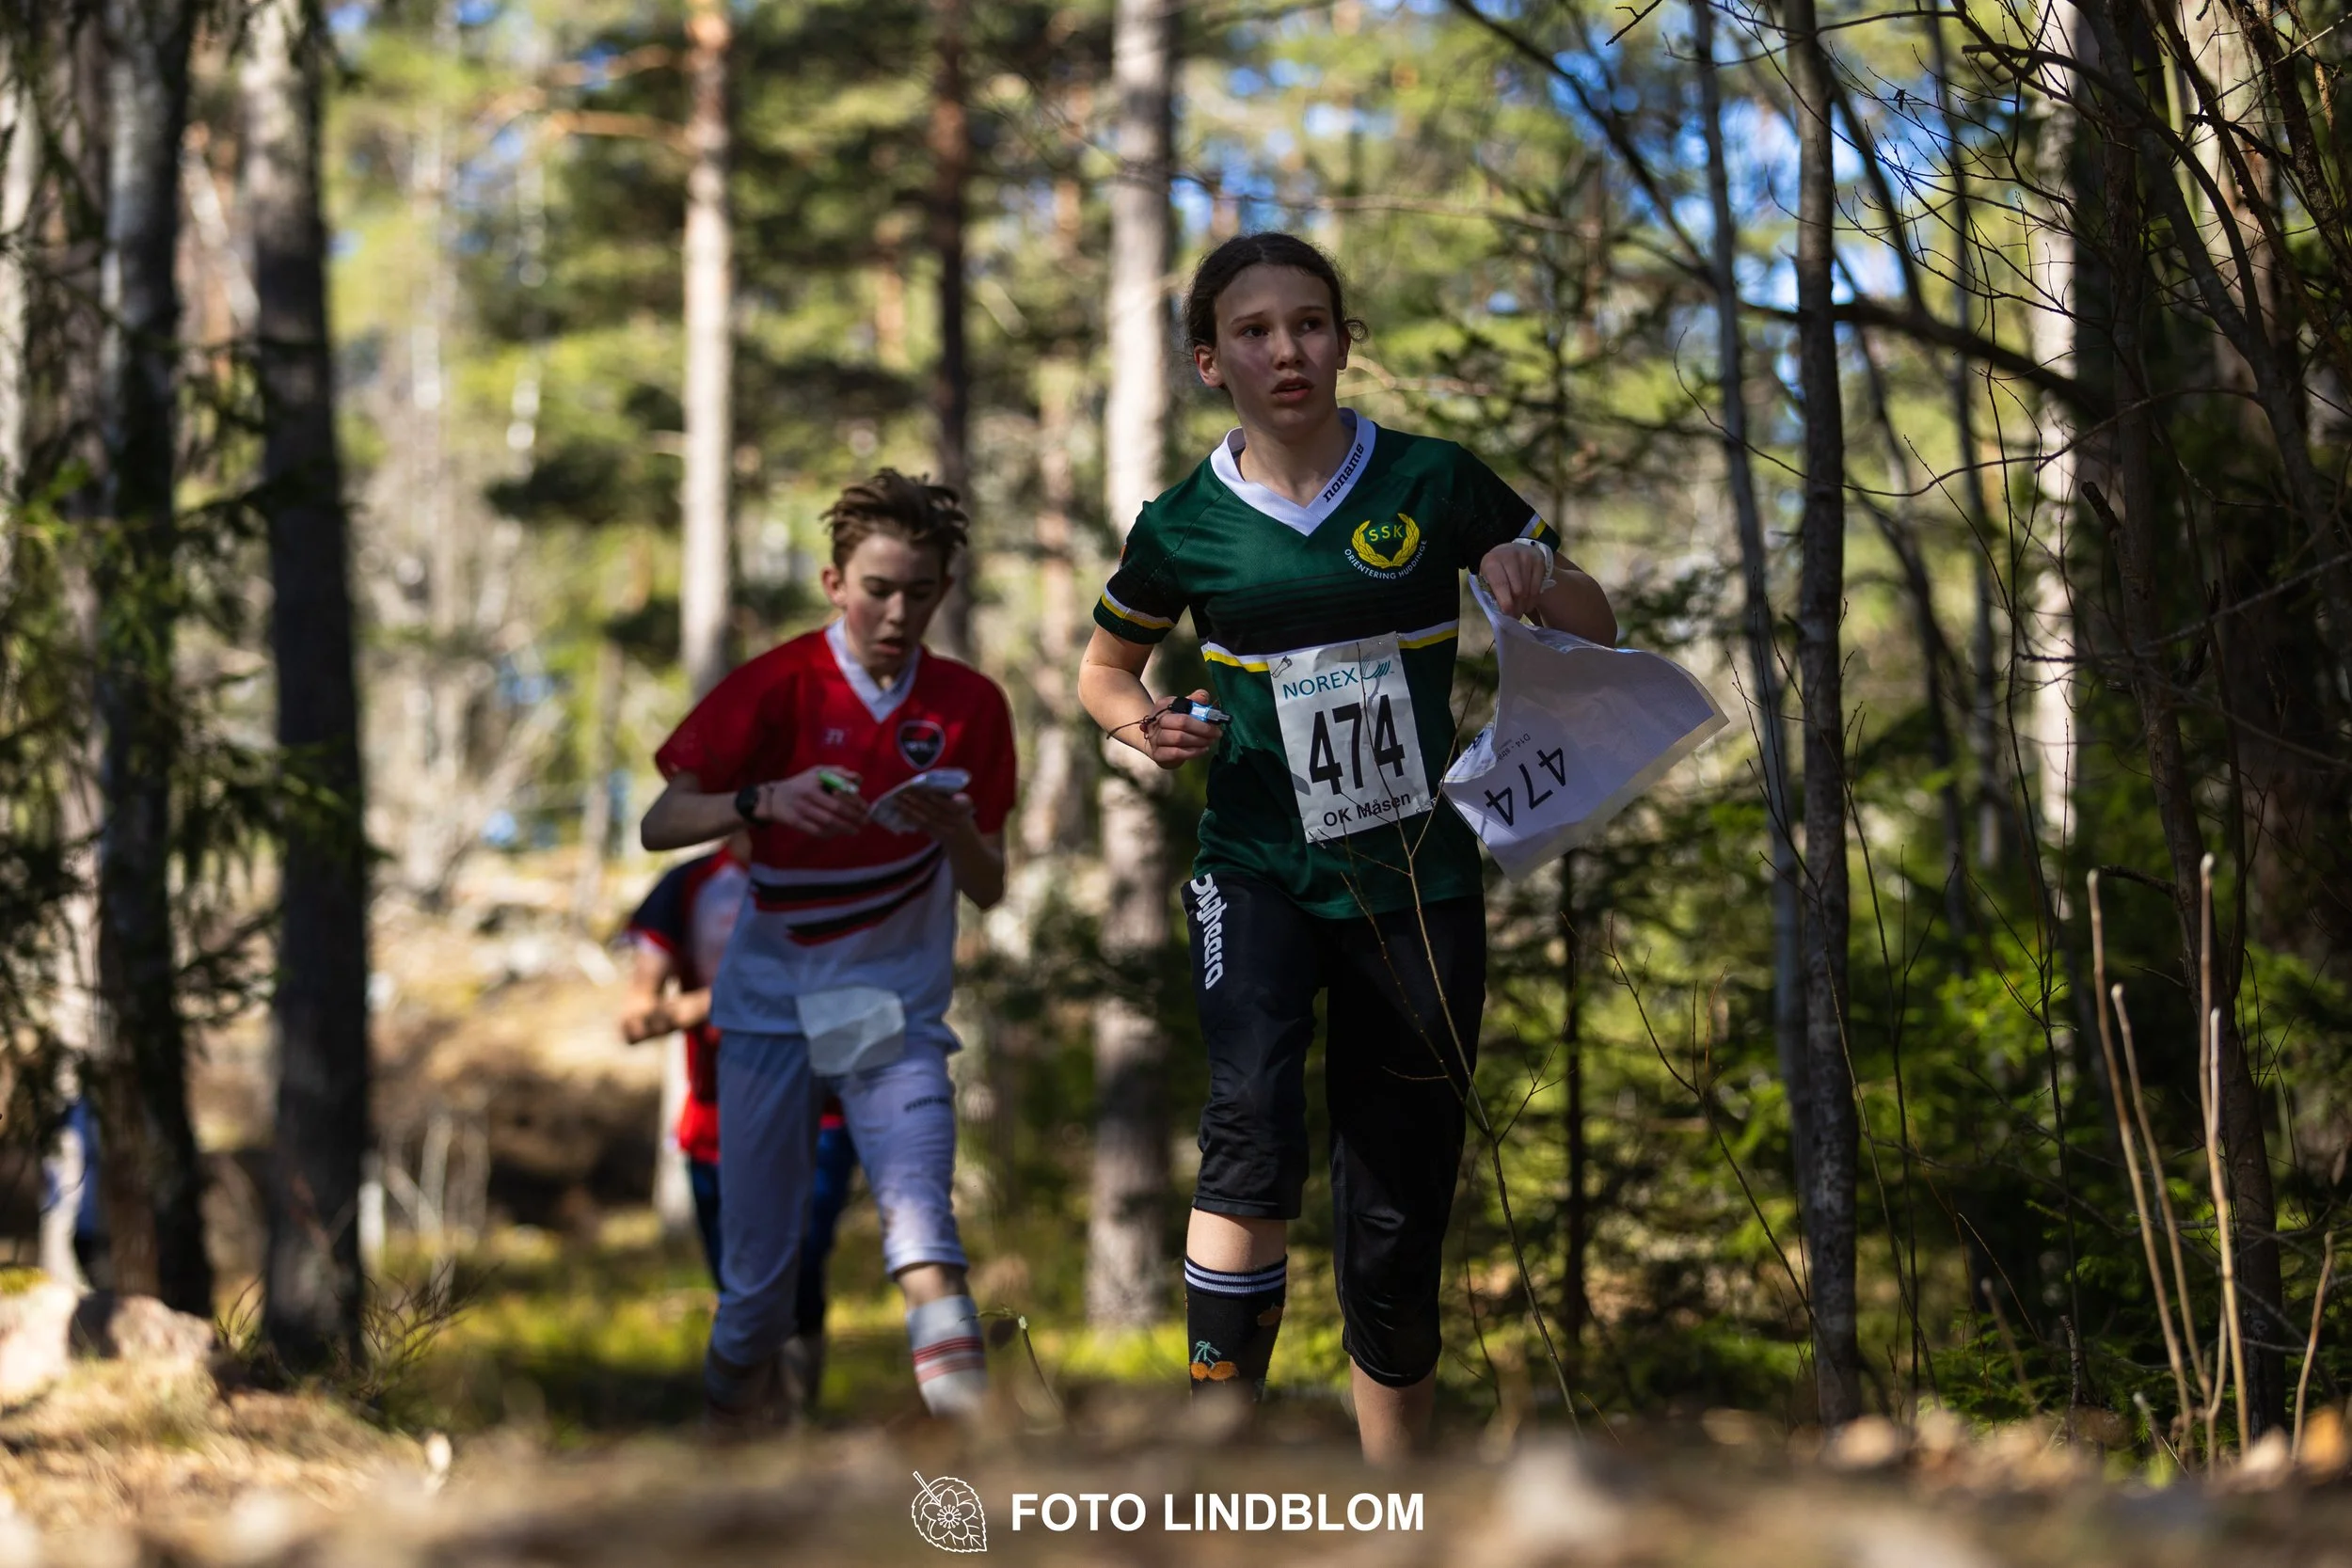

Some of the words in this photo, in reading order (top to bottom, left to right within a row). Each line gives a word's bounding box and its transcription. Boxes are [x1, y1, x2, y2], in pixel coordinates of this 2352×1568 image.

[1323, 443, 1364, 503] noname
[1368, 524, 1404, 542] SSK
[1344, 548, 1397, 579] ORIENTERING
[1398, 540, 1427, 578] HUDDINGE
[1282, 667, 1359, 700] NOREX
[1309, 693, 1406, 795] 474
[1484, 747, 1566, 827] 474
[1323, 807, 1353, 827] OK
[1356, 792, 1411, 819] Måsen
